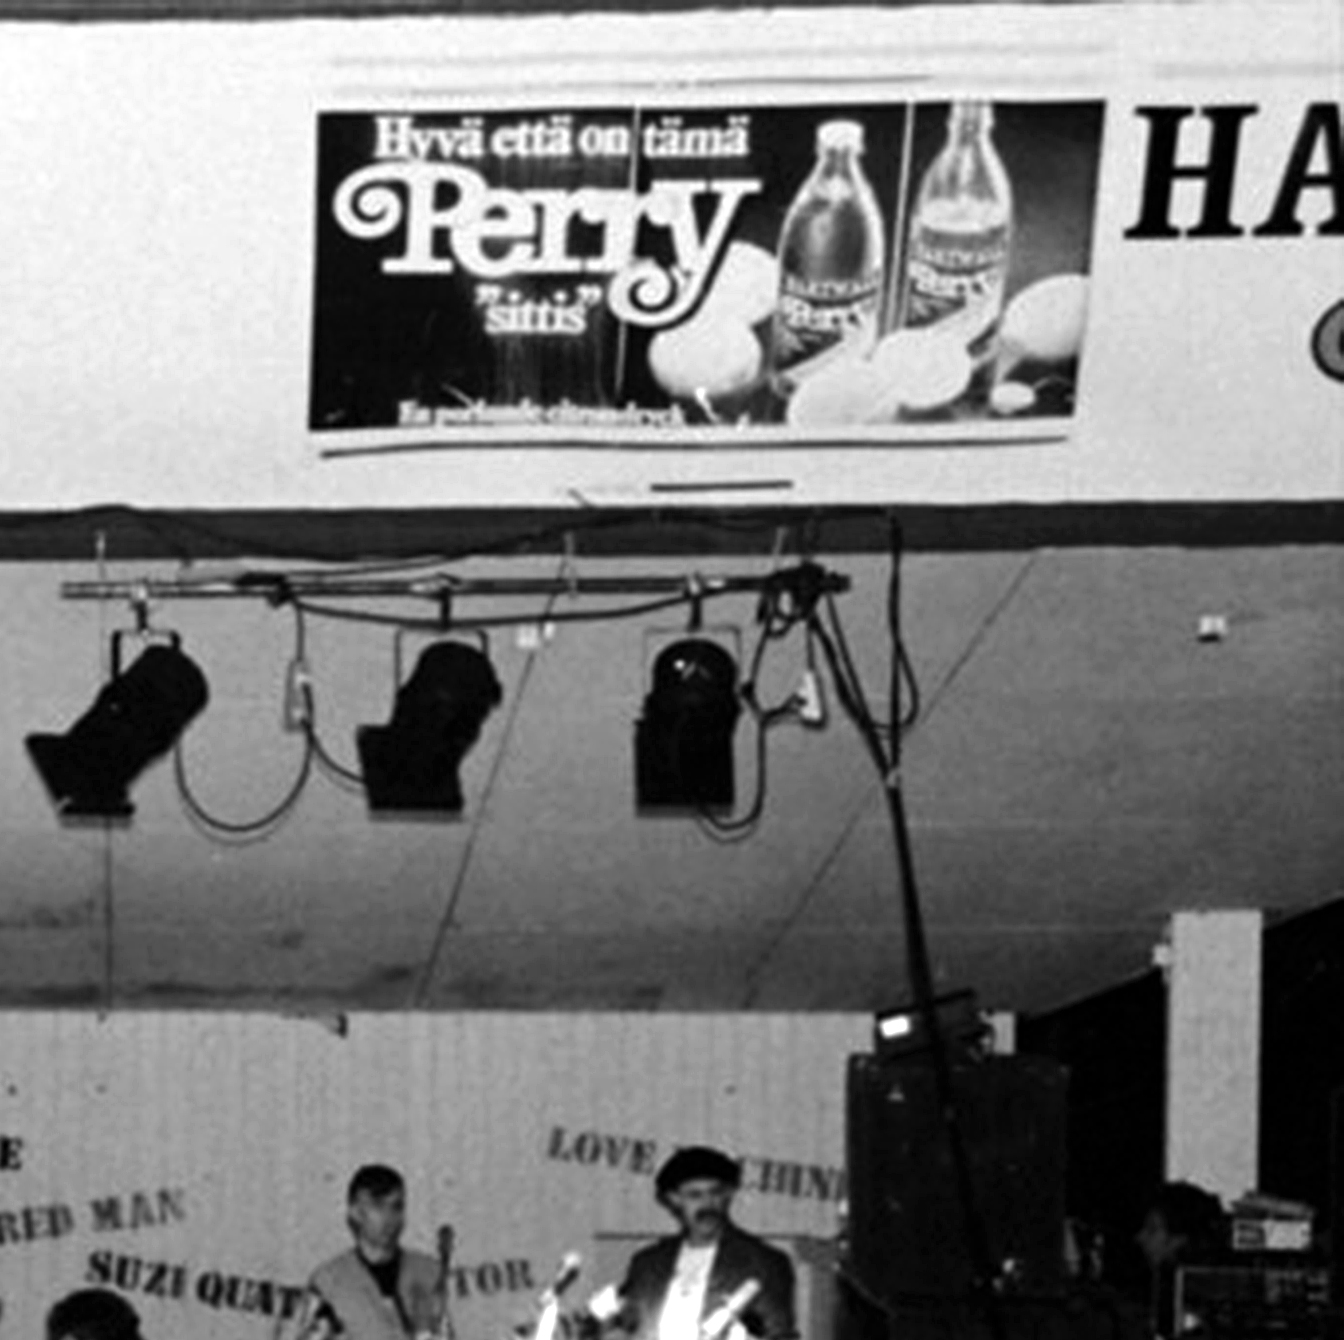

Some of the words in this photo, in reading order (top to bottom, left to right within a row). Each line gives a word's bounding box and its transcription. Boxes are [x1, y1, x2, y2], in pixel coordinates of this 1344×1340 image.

[374, 115, 484, 161] Hyvä
[490, 114, 573, 157] että
[578, 123, 630, 157] on
[643, 114, 751, 158] tämä
[333, 160, 763, 328] Perry
[546, 1126, 658, 1177] LOVE
[91, 1187, 187, 1232] MAN
[84, 1250, 186, 1299] SUZI
